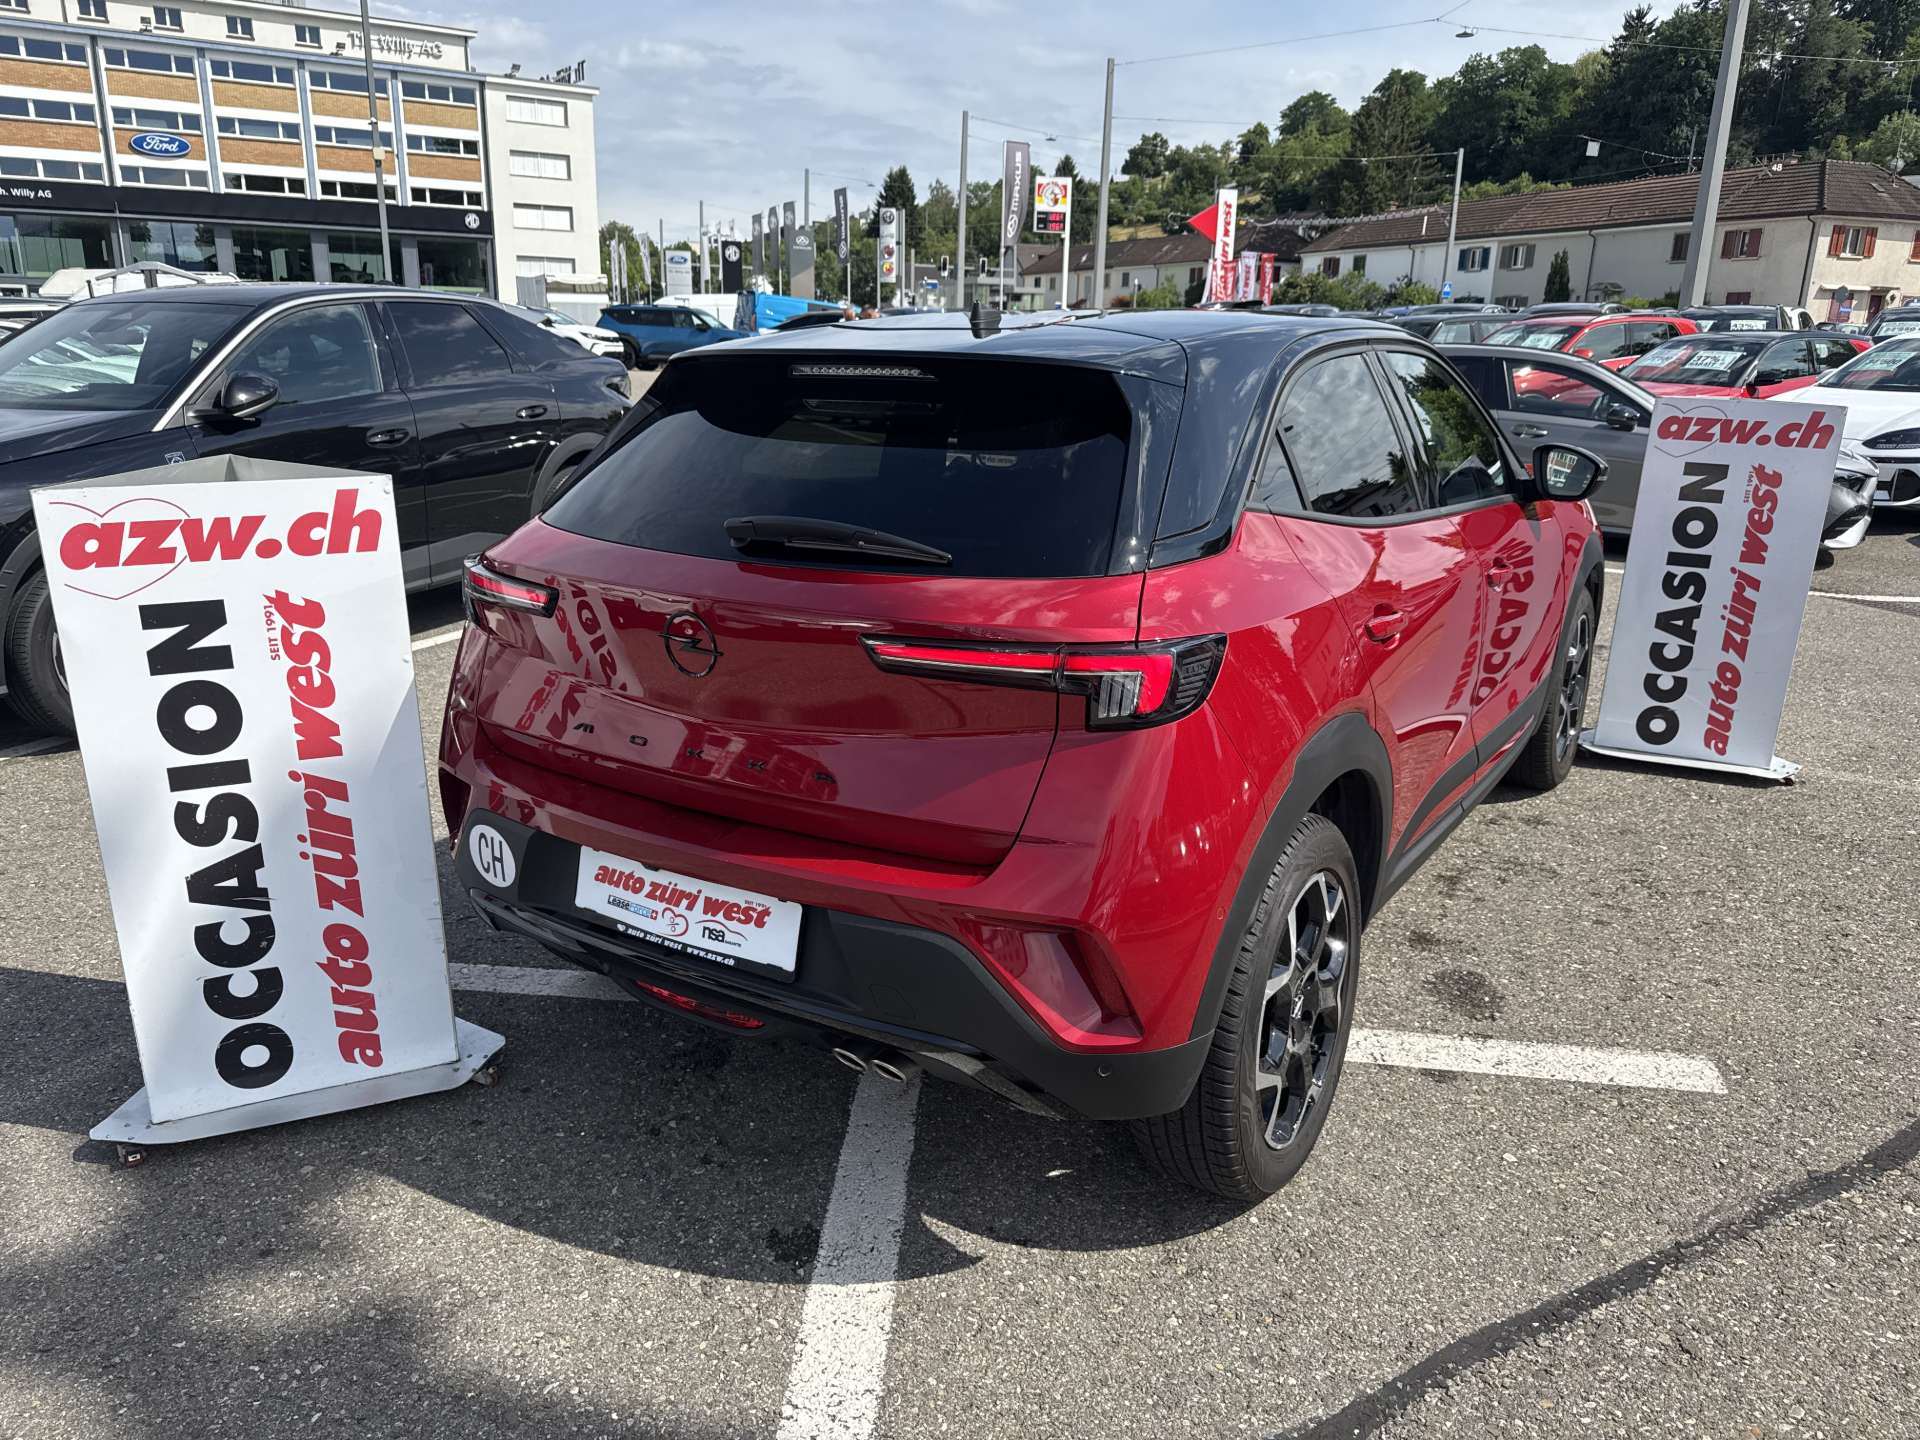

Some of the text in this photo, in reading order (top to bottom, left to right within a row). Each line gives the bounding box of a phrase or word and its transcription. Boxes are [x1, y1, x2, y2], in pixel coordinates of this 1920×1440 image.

[143, 136, 179, 152] Ford
[10, 187, 35, 199] Willy
[37, 190, 52, 199] AG
[1011, 151, 1022, 212] MAXUS
[1656, 411, 1836, 449] azw.ch
[59, 488, 383, 572] azw.ch
[1635, 461, 1730, 746] OCCASION
[1703, 463, 1783, 756] auto züri west
[263, 605, 281, 661] SEIT 1991
[138, 598, 294, 1090] OCCASION
[262, 589, 383, 1067] auto züri west
[478, 832, 506, 882] CH
[594, 865, 772, 928] auto züri west
[626, 928, 645, 938] auto
[664, 940, 683, 951] west
[702, 926, 726, 943] nsa
